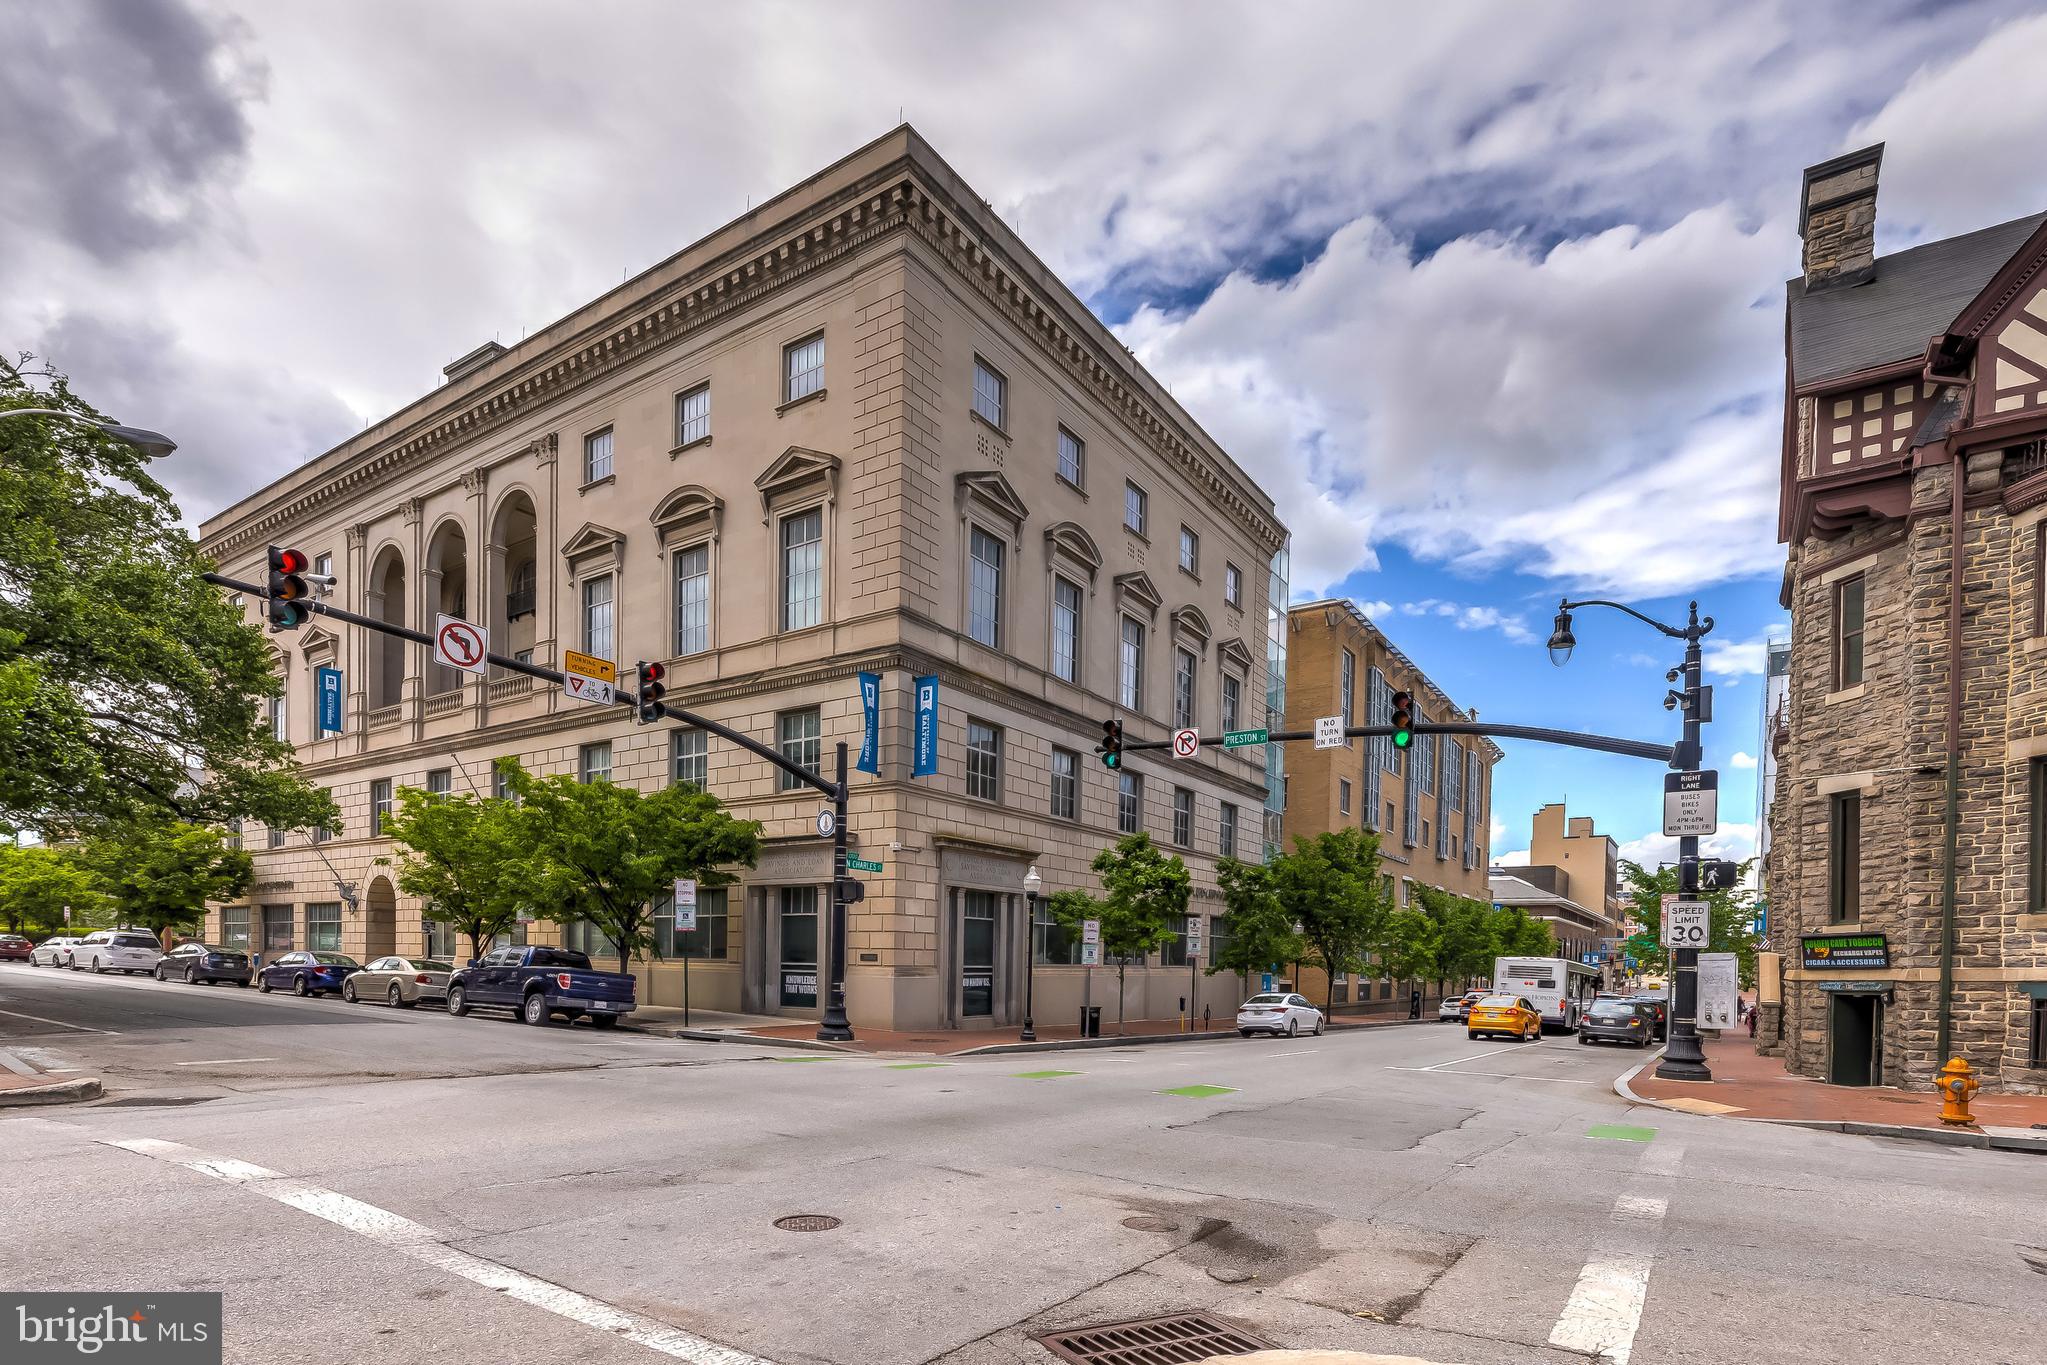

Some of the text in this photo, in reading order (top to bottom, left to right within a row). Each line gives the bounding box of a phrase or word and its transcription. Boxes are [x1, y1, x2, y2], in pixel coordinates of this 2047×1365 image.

[571, 655, 596, 666] TURNING
[571, 664, 596, 675] VEHICLES
[923, 690, 931, 701] B
[1324, 719, 1336, 728] NO
[1321, 728, 1339, 737] TURN
[1225, 733, 1258, 745] PRESTON
[1316, 736, 1342, 747] ON RED
[853, 860, 877, 871] CHARLES
[1671, 926, 1704, 942] 30
[1830, 938, 1847, 948] CAVE
[1849, 937, 1883, 947] TOBACCO
[1836, 958, 1886, 966] ACCESSORIES
[785, 975, 817, 985] KNOWLEDGE
[785, 984, 818, 995] THAT WORKS
